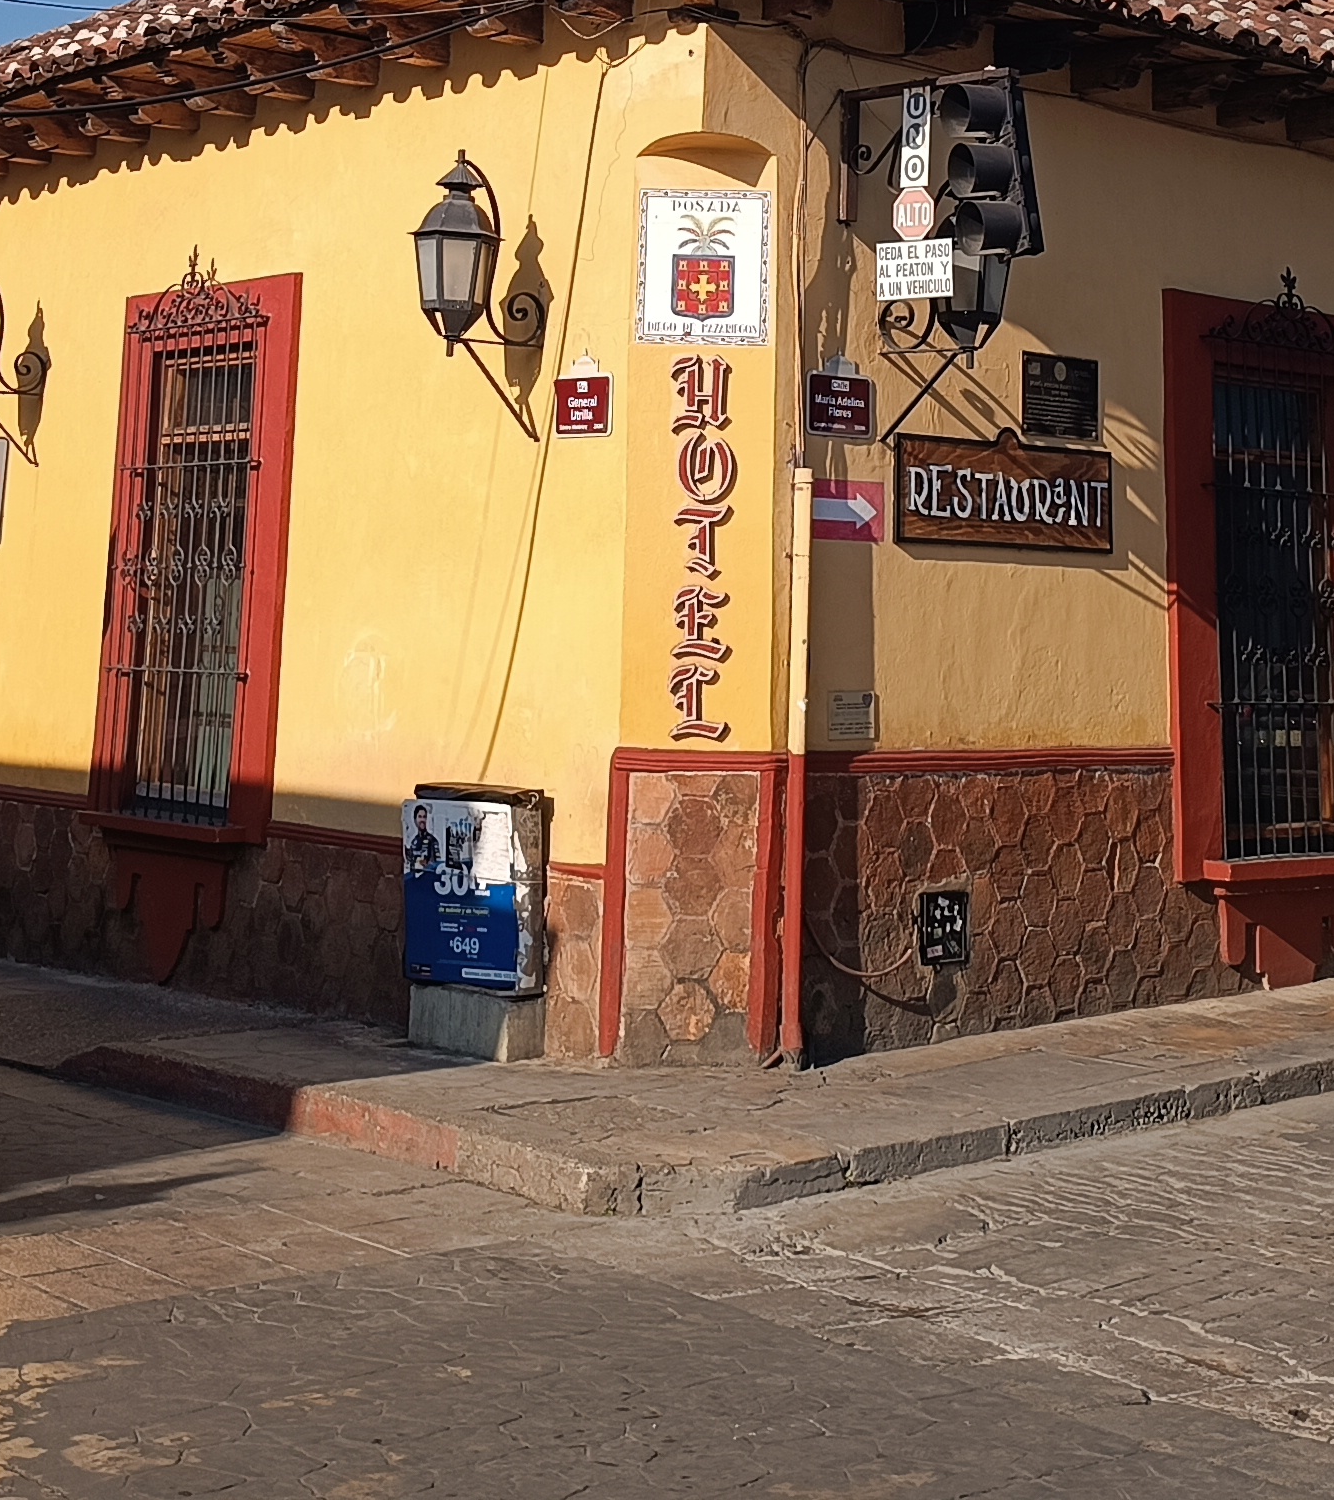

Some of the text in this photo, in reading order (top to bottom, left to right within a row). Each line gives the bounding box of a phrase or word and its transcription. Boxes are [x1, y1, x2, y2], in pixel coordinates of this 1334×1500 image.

[905, 92, 927, 182] UNO
[671, 199, 742, 214] POSADA
[896, 202, 930, 228] ALTO
[878, 243, 950, 261] CEDA EL PASO
[878, 260, 950, 279] AL PEATON Y
[878, 278, 951, 298] A UN VEHICULO
[647, 320, 758, 335] DIEGO DE MAZARIEGOS
[832, 381, 848, 390] Calle
[567, 395, 598, 408] General
[815, 393, 865, 408] María Adelina
[828, 406, 853, 418] Flores
[669, 354, 738, 743] HOTEL
[449, 936, 480, 954] $649
